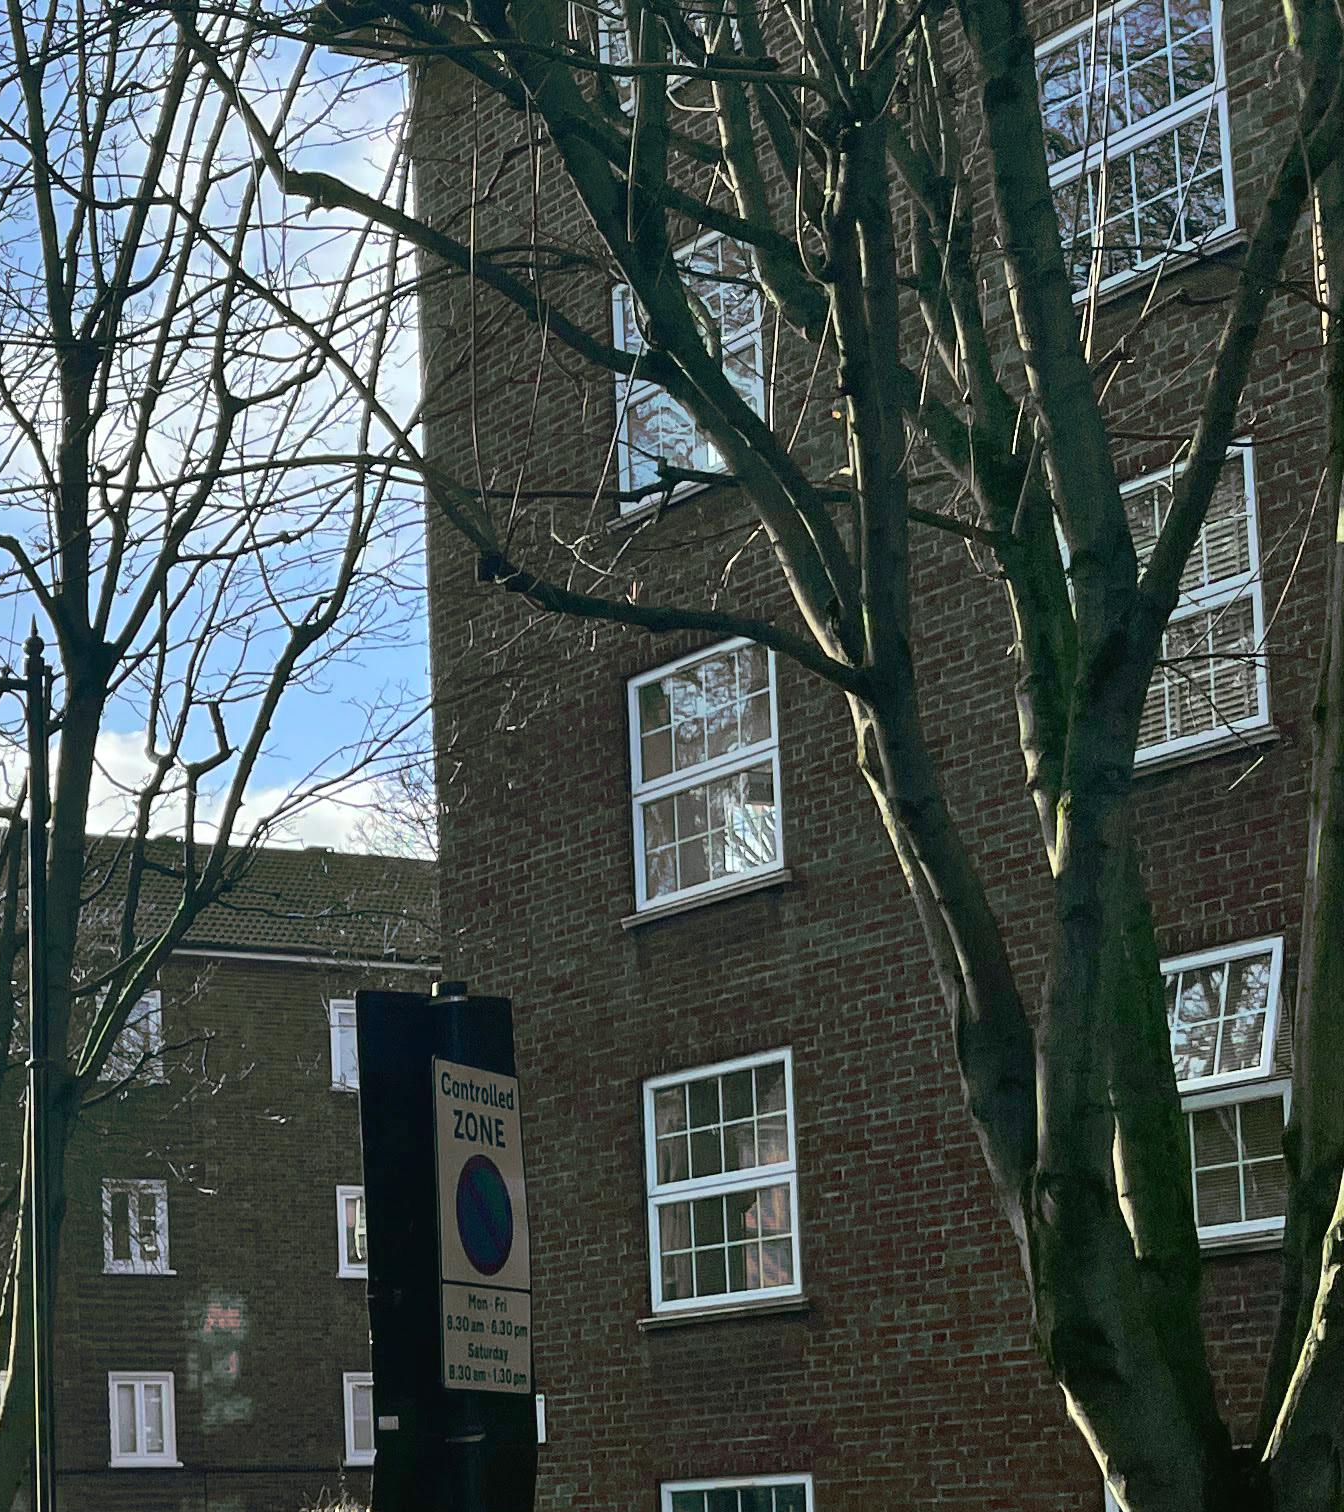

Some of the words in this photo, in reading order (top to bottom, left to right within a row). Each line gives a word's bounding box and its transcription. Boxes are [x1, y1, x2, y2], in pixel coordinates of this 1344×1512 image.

[441, 1071, 514, 1111] Controlled
[453, 1109, 506, 1148] ZONE
[468, 1294, 488, 1310] Mon
[494, 1296, 508, 1312] Fri
[447, 1314, 469, 1331] 8.30
[471, 1321, 484, 1333] am
[514, 1325, 528, 1339] pm
[468, 1343, 508, 1363] Saturday
[473, 1369, 486, 1382] am
[493, 1368, 512, 1384] 1.30
[513, 1373, 527, 1386] pm
